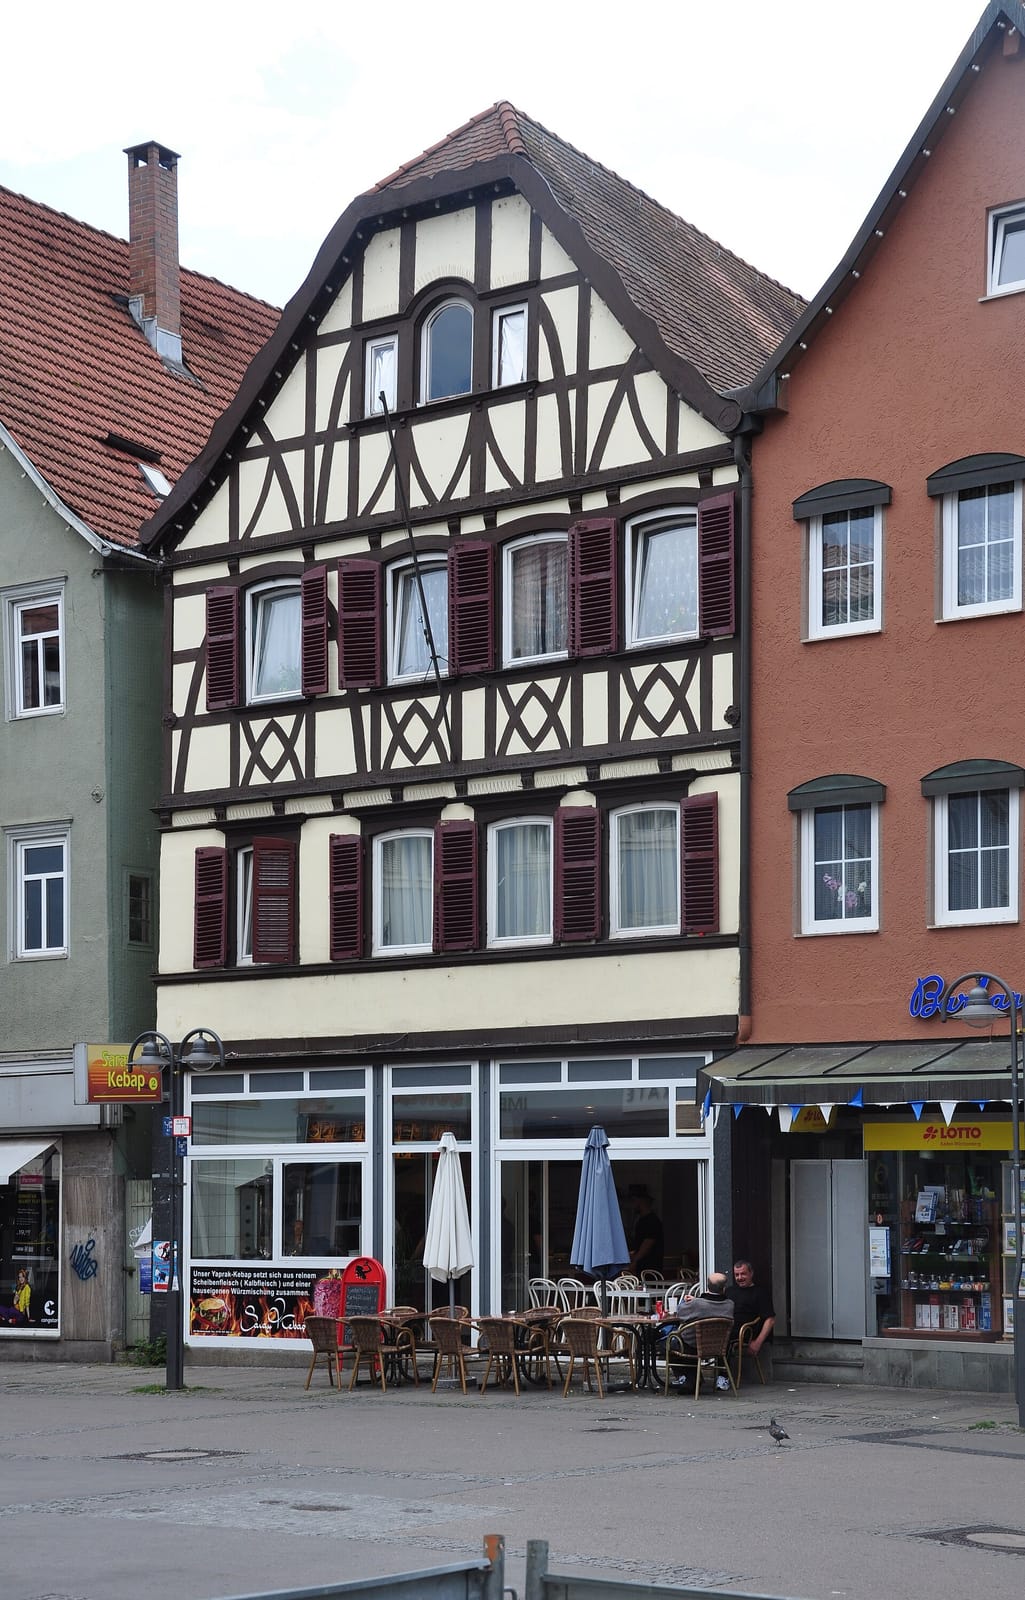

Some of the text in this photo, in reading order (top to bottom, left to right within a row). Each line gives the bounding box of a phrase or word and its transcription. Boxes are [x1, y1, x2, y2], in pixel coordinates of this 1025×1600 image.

[107, 1071, 146, 1092] Kebap
[940, 1127, 981, 1138] LOTTO
[211, 1270, 252, 1279] Yaprak-Kebap
[193, 1287, 230, 1296] hauseigenen
[230, 1287, 275, 1297] Würzmischung
[240, 1297, 307, 1333] Saray Kebap
